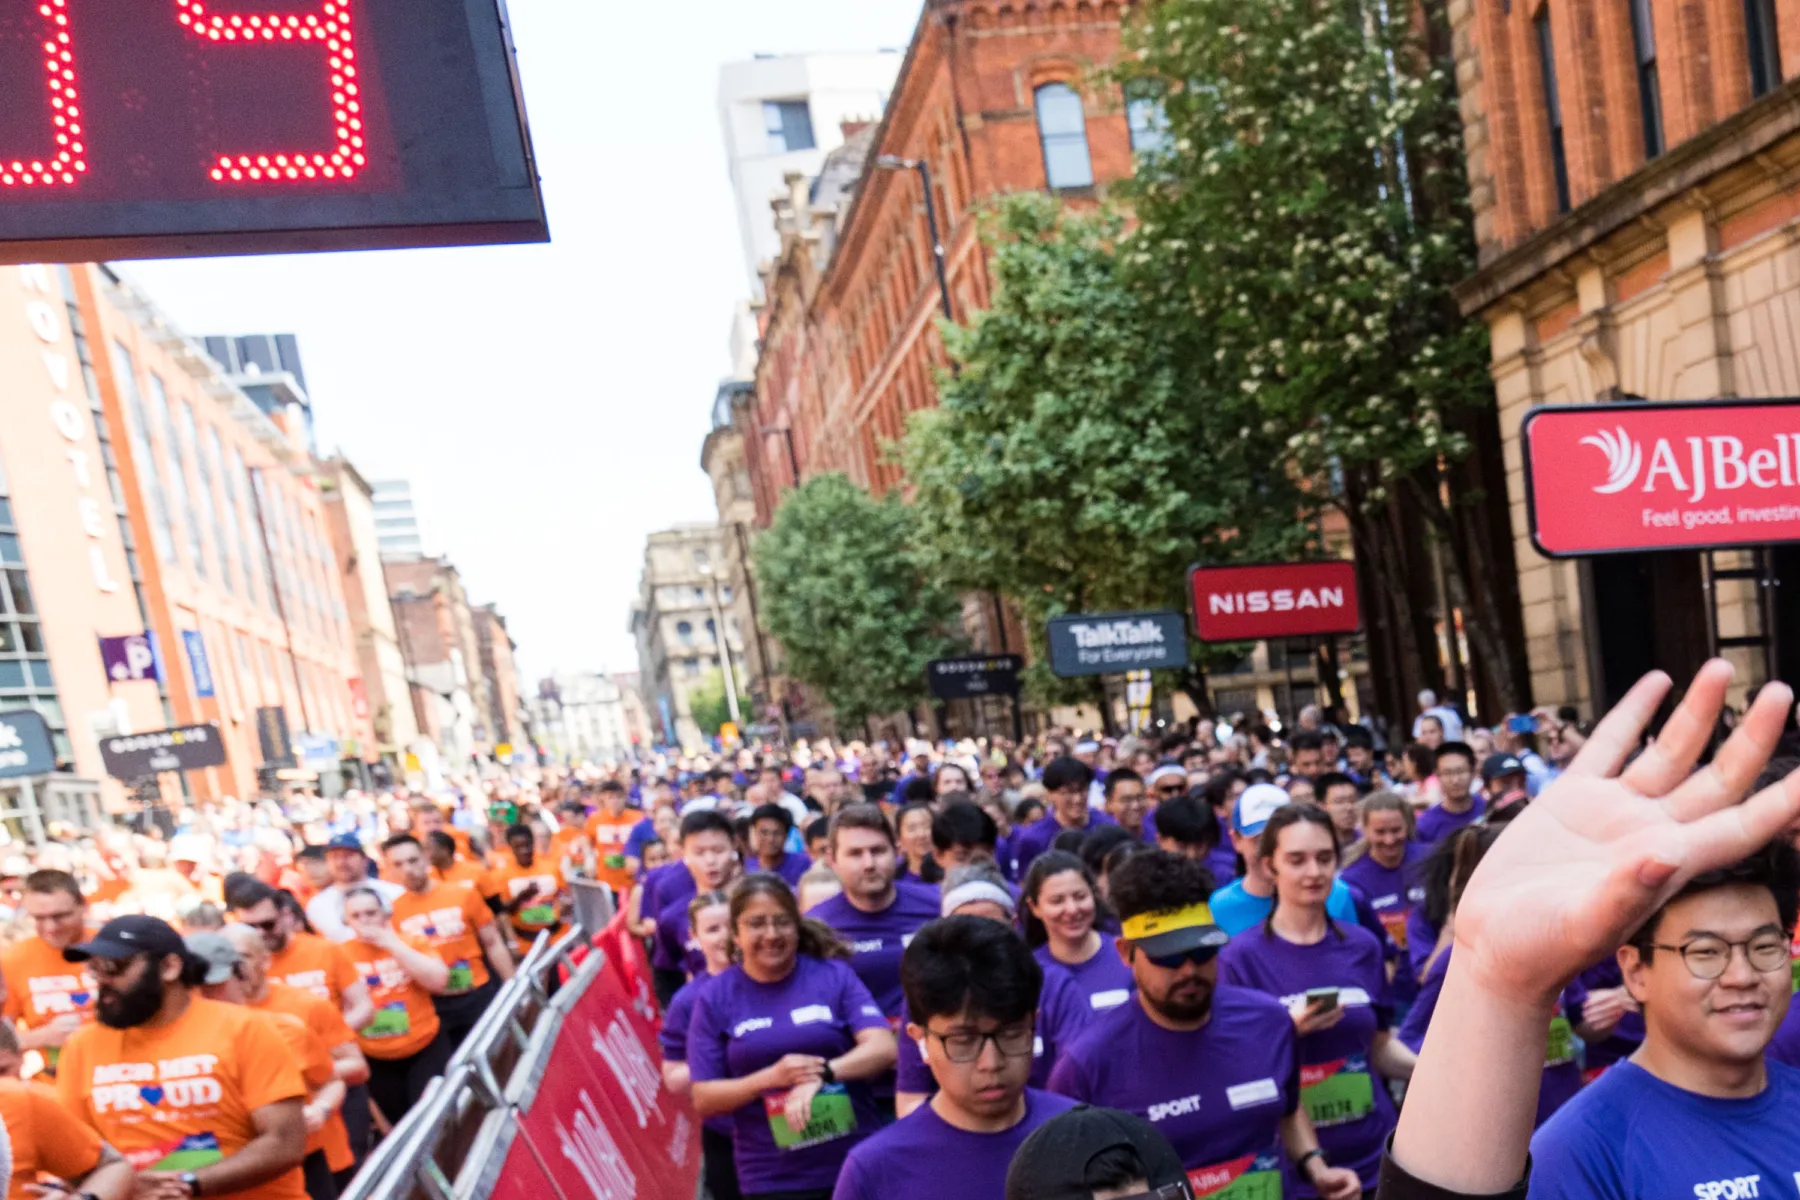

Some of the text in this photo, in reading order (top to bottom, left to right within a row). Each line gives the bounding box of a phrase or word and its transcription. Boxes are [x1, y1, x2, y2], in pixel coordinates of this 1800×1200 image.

[1642, 507, 1680, 527] Feel
[1208, 587, 1344, 614] NISSAN
[1068, 619, 1165, 648] TalkTalk
[1148, 1095, 1200, 1121] SPORT
